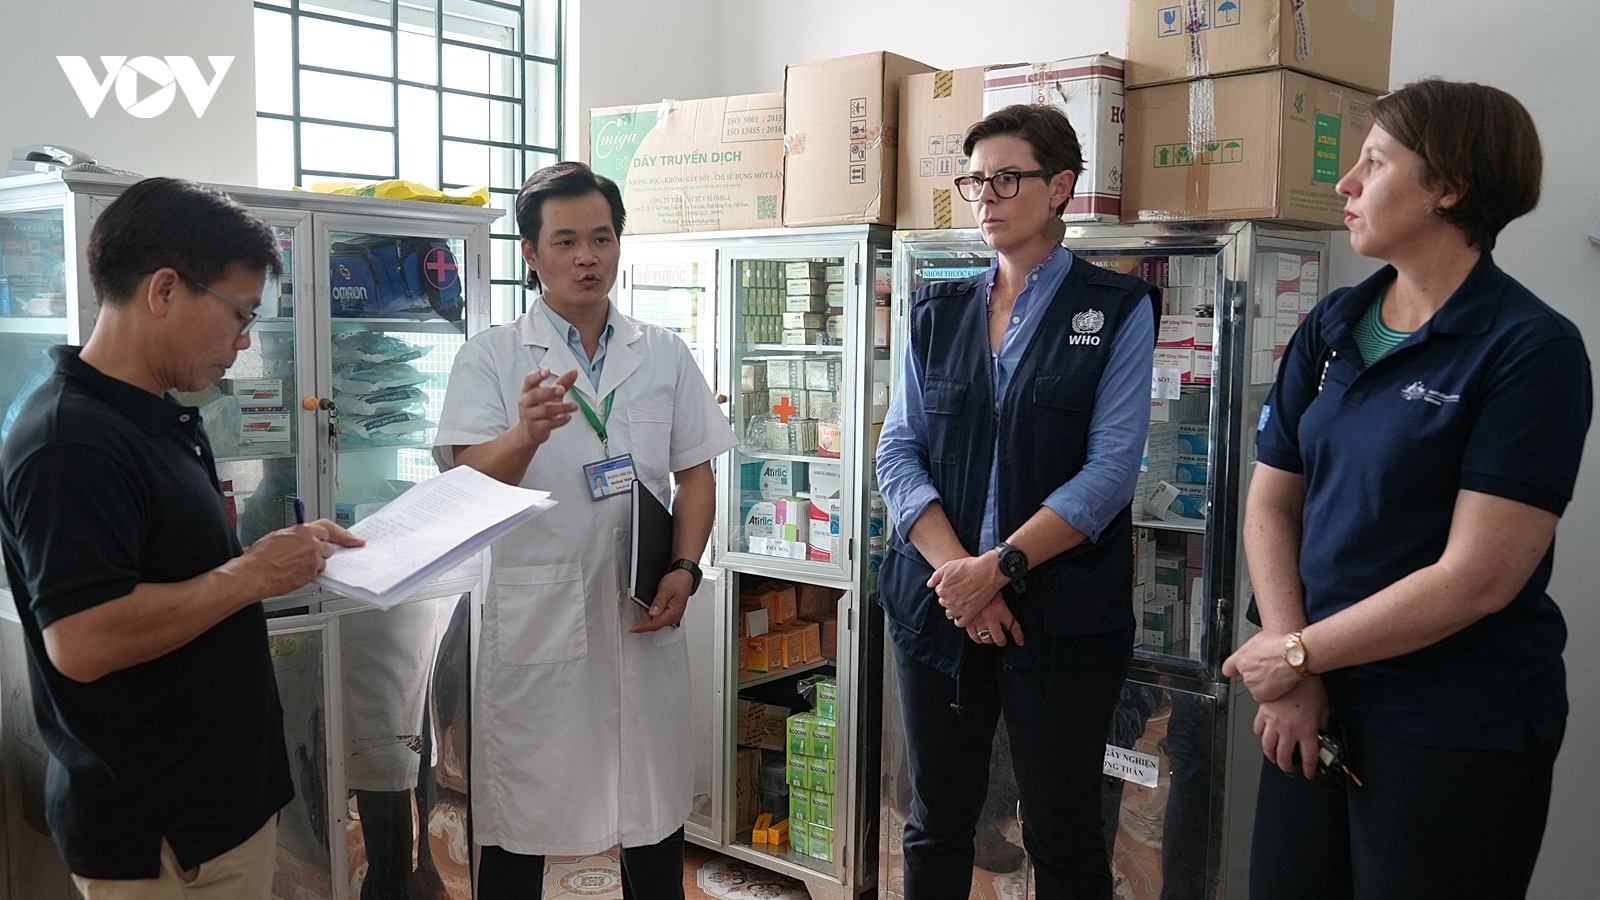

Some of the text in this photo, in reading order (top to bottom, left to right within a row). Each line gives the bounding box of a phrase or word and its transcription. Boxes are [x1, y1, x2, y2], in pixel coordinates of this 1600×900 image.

[728, 117, 740, 125] ISO
[766, 114, 783, 122] 2015
[741, 127, 760, 135] 13485
[766, 126, 782, 134] 2016
[634, 154, 657, 168] DÂY
[660, 149, 708, 166] TRUYỀN
[712, 151, 742, 166] DỊCH
[333, 286, 368, 300] OMRON
[1069, 335, 1100, 346] WHO
[789, 728, 807, 736] ACOCINA
[788, 760, 805, 769] ACOCINA
[1123, 754, 1156, 768] NGHIỆN
[810, 765, 827, 774] ACOCINA
